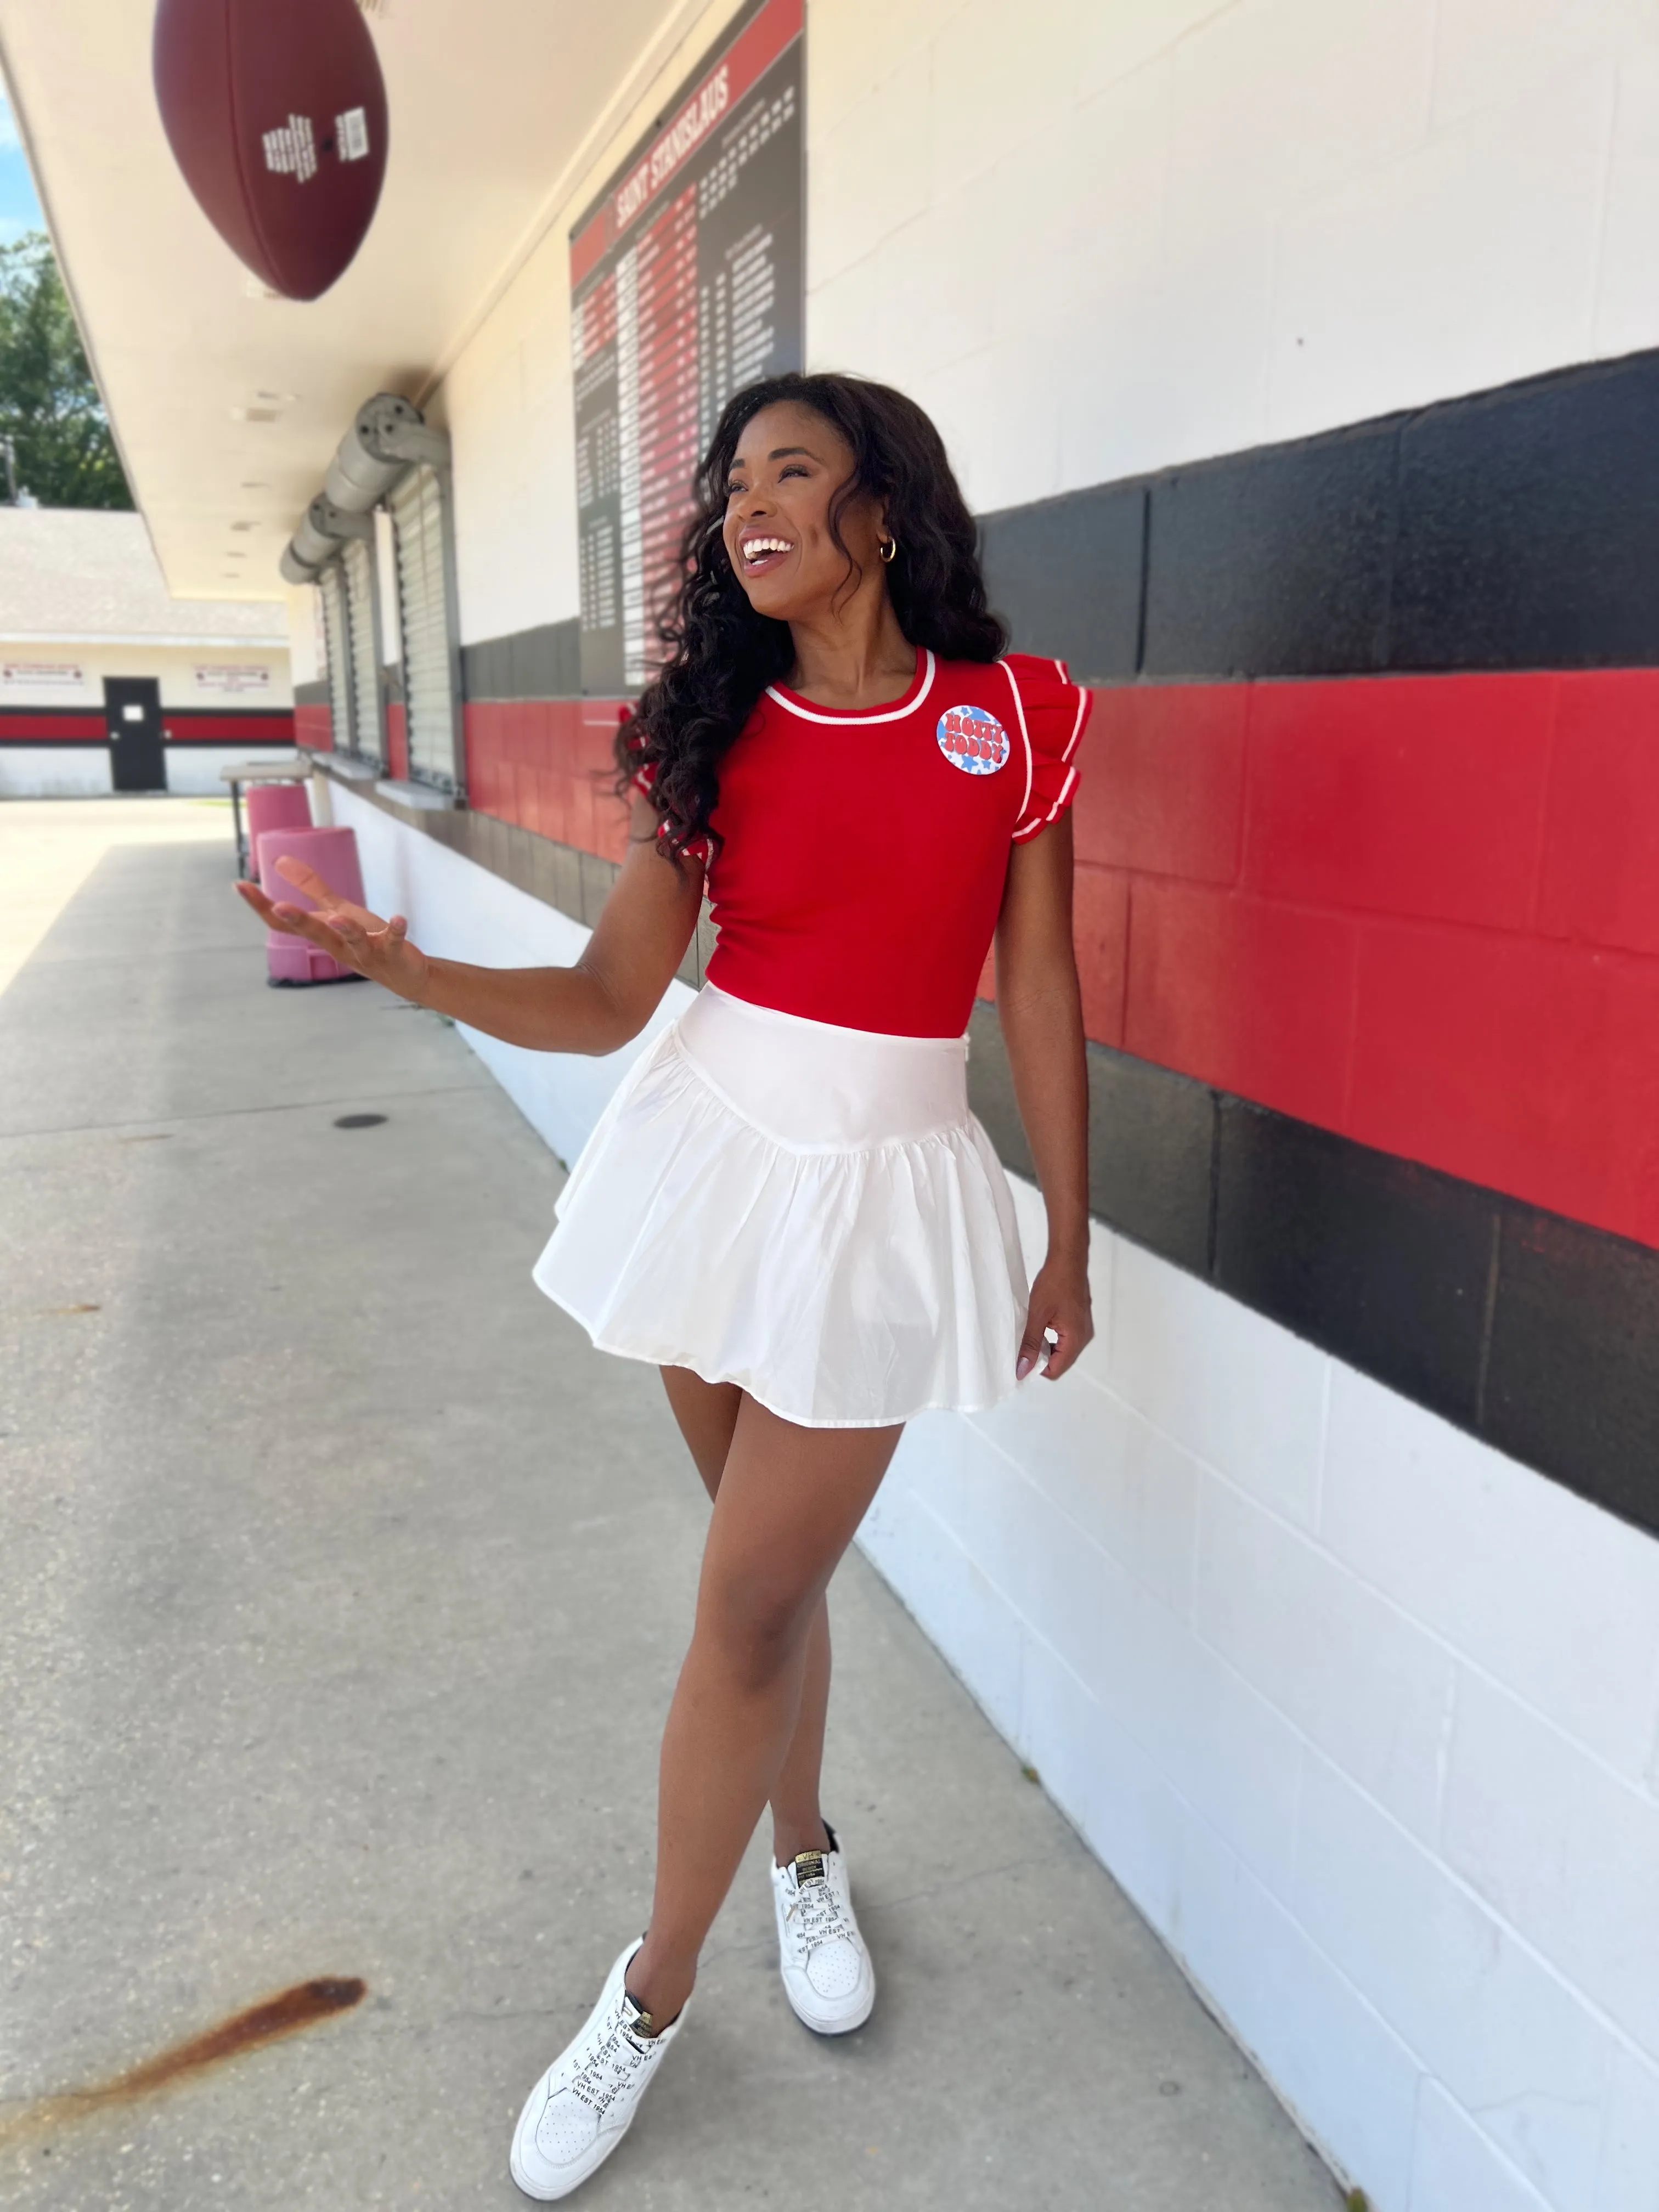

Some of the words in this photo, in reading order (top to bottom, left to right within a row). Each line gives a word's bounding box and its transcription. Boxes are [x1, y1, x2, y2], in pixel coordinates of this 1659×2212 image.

[617, 163, 648, 228] SAINT
[651, 64, 728, 190] STANISLAUS
[945, 713, 1003, 744] HOTTY
[945, 732, 1003, 764] TODDY
[619, 2019, 631, 2032] EST
[601, 2045, 611, 2059] EST
[580, 2072, 591, 2084] 1954
[589, 2070, 603, 2080] 1954
[572, 2087, 581, 2097] VH
[580, 2095, 593, 2106] EST
[593, 2104, 606, 2115] 1954
[577, 2081, 586, 2090] VH
[586, 2087, 600, 2095] EST
[602, 2091, 616, 2101] 1954
